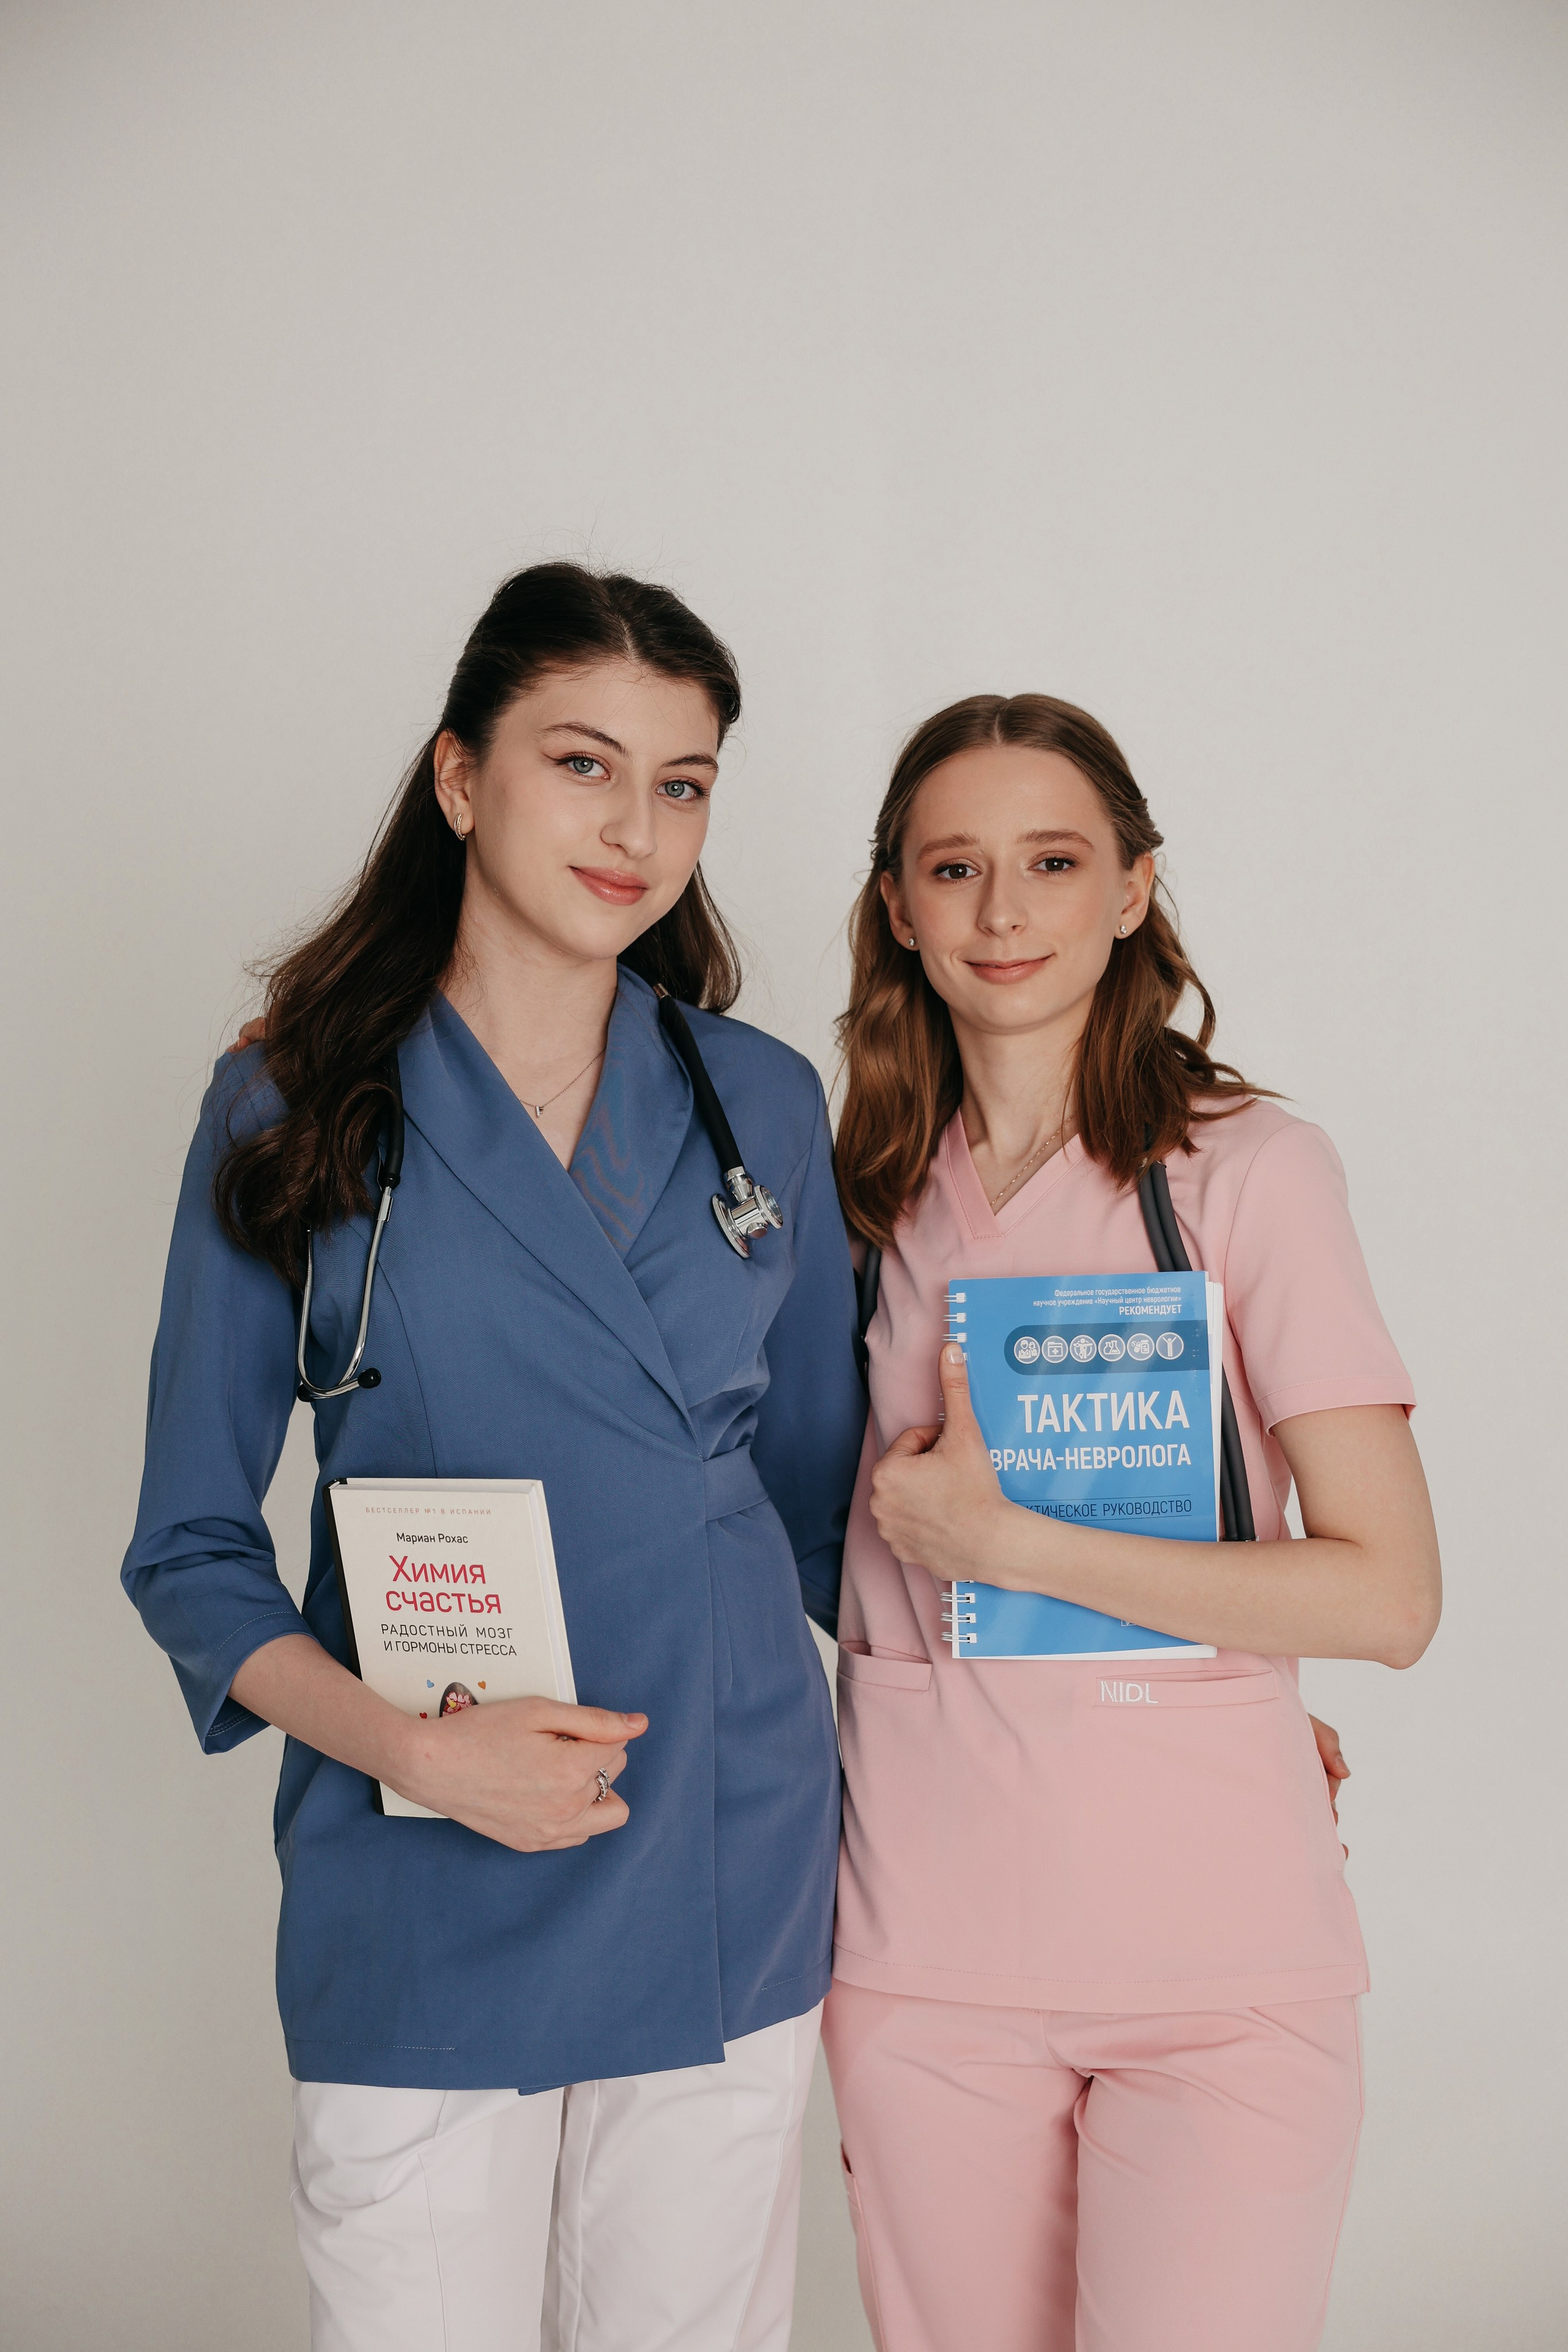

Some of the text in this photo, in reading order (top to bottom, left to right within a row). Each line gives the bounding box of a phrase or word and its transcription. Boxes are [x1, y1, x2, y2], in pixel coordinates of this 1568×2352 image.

[1095, 1288, 1145, 1297] государственное
[1057, 1298, 1093, 1307] учреждение
[1095, 1297, 1124, 1305] «Научный
[1118, 1304, 1182, 1316] РЕКОМЕНДУЕТ
[1017, 1390, 1190, 1433] ТАКТИКА
[989, 1443, 1192, 1471] ВРАЧА-НЕВРОЛОГА
[1102, 1499, 1193, 1517] РУКОВОДСТВО
[396, 1532, 469, 1545] Мариан Рохас
[388, 1555, 486, 1585] Химия
[380, 1624, 513, 1639] РАДОСТНЫЙ МОЗГ
[383, 1640, 518, 1656] И ГОРМОНЫ СТРЕССА
[1100, 1680, 1159, 1704] NIDL
